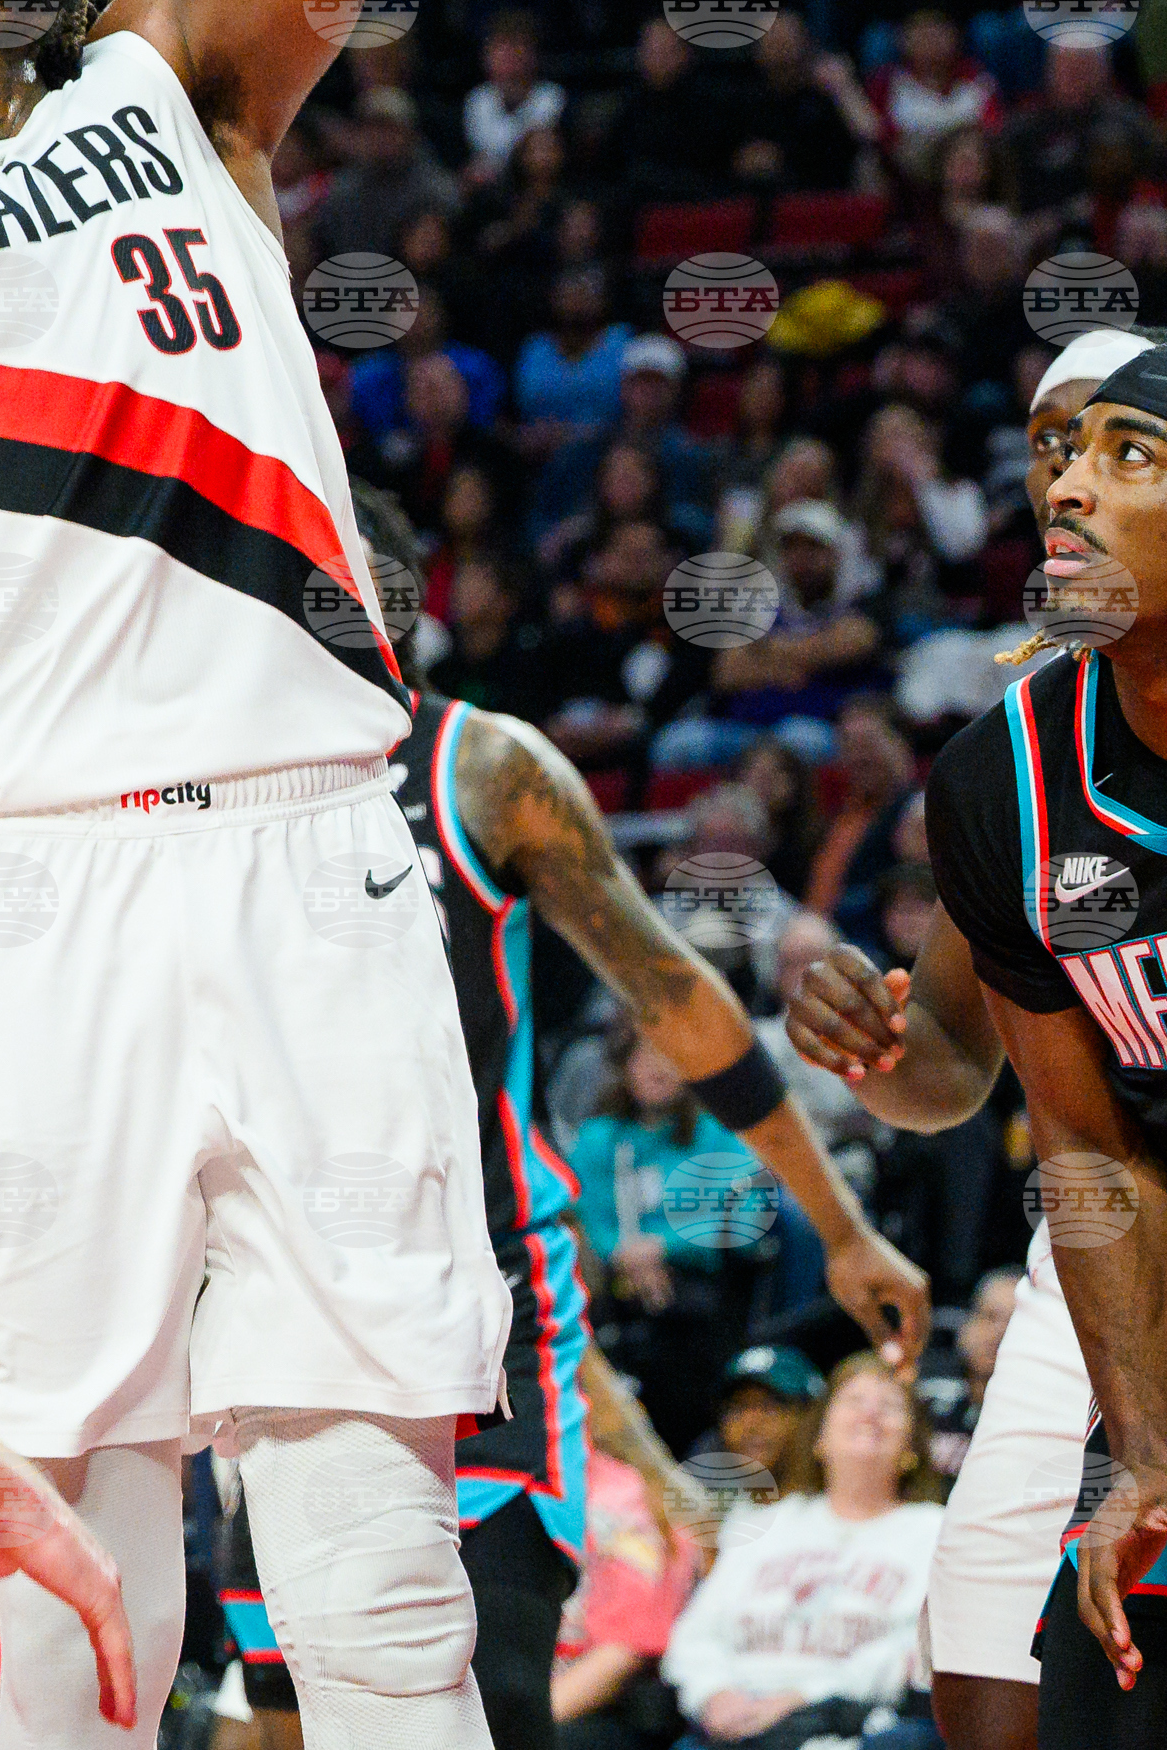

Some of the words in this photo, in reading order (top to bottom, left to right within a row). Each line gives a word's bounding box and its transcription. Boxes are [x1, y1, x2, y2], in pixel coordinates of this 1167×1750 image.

[110, 227, 243, 356] 35
[1061, 856, 1109, 884] NIKE
[1056, 929, 1167, 1070] ME
